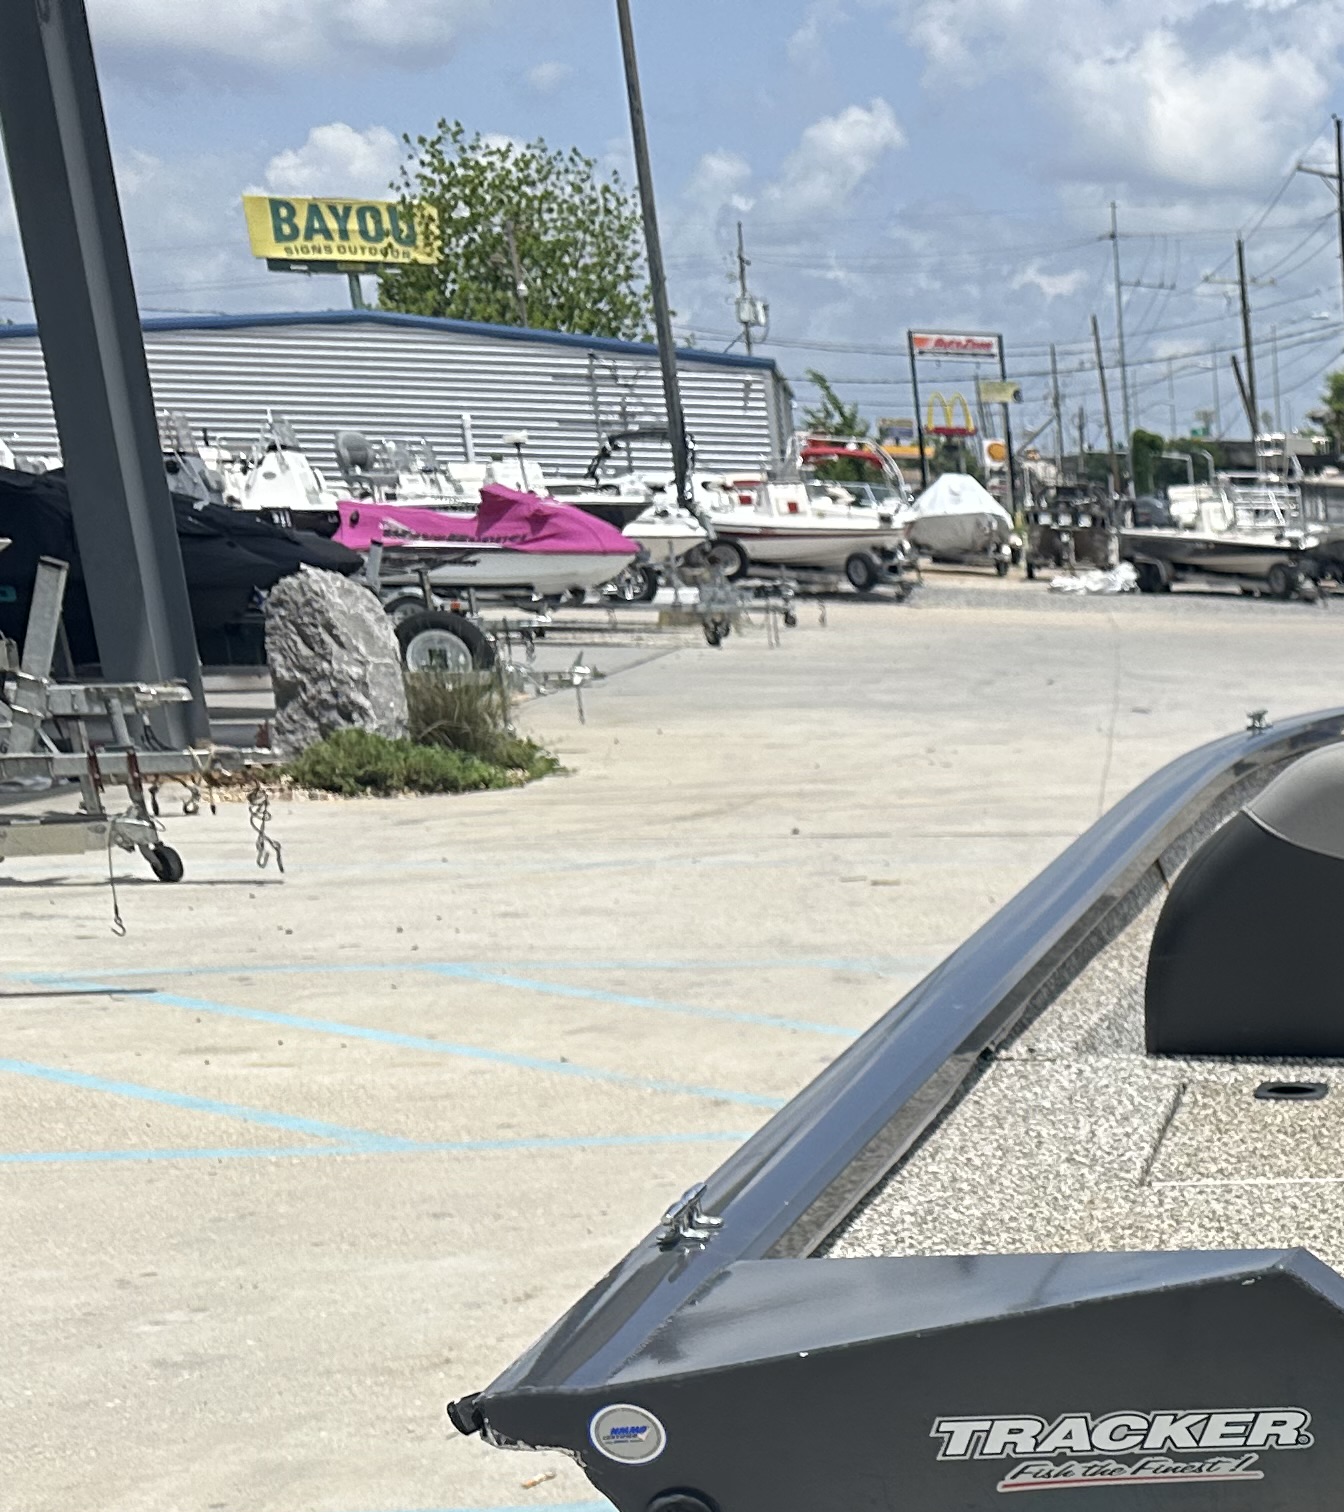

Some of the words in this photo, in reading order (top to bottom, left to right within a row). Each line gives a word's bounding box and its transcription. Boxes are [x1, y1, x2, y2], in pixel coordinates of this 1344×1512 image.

[268, 197, 417, 248] BAYOU
[284, 244, 333, 256] SIGNS
[934, 1409, 1310, 1458] TRACKER
[1010, 1463, 1076, 1480] Fish
[1082, 1462, 1127, 1477] the
